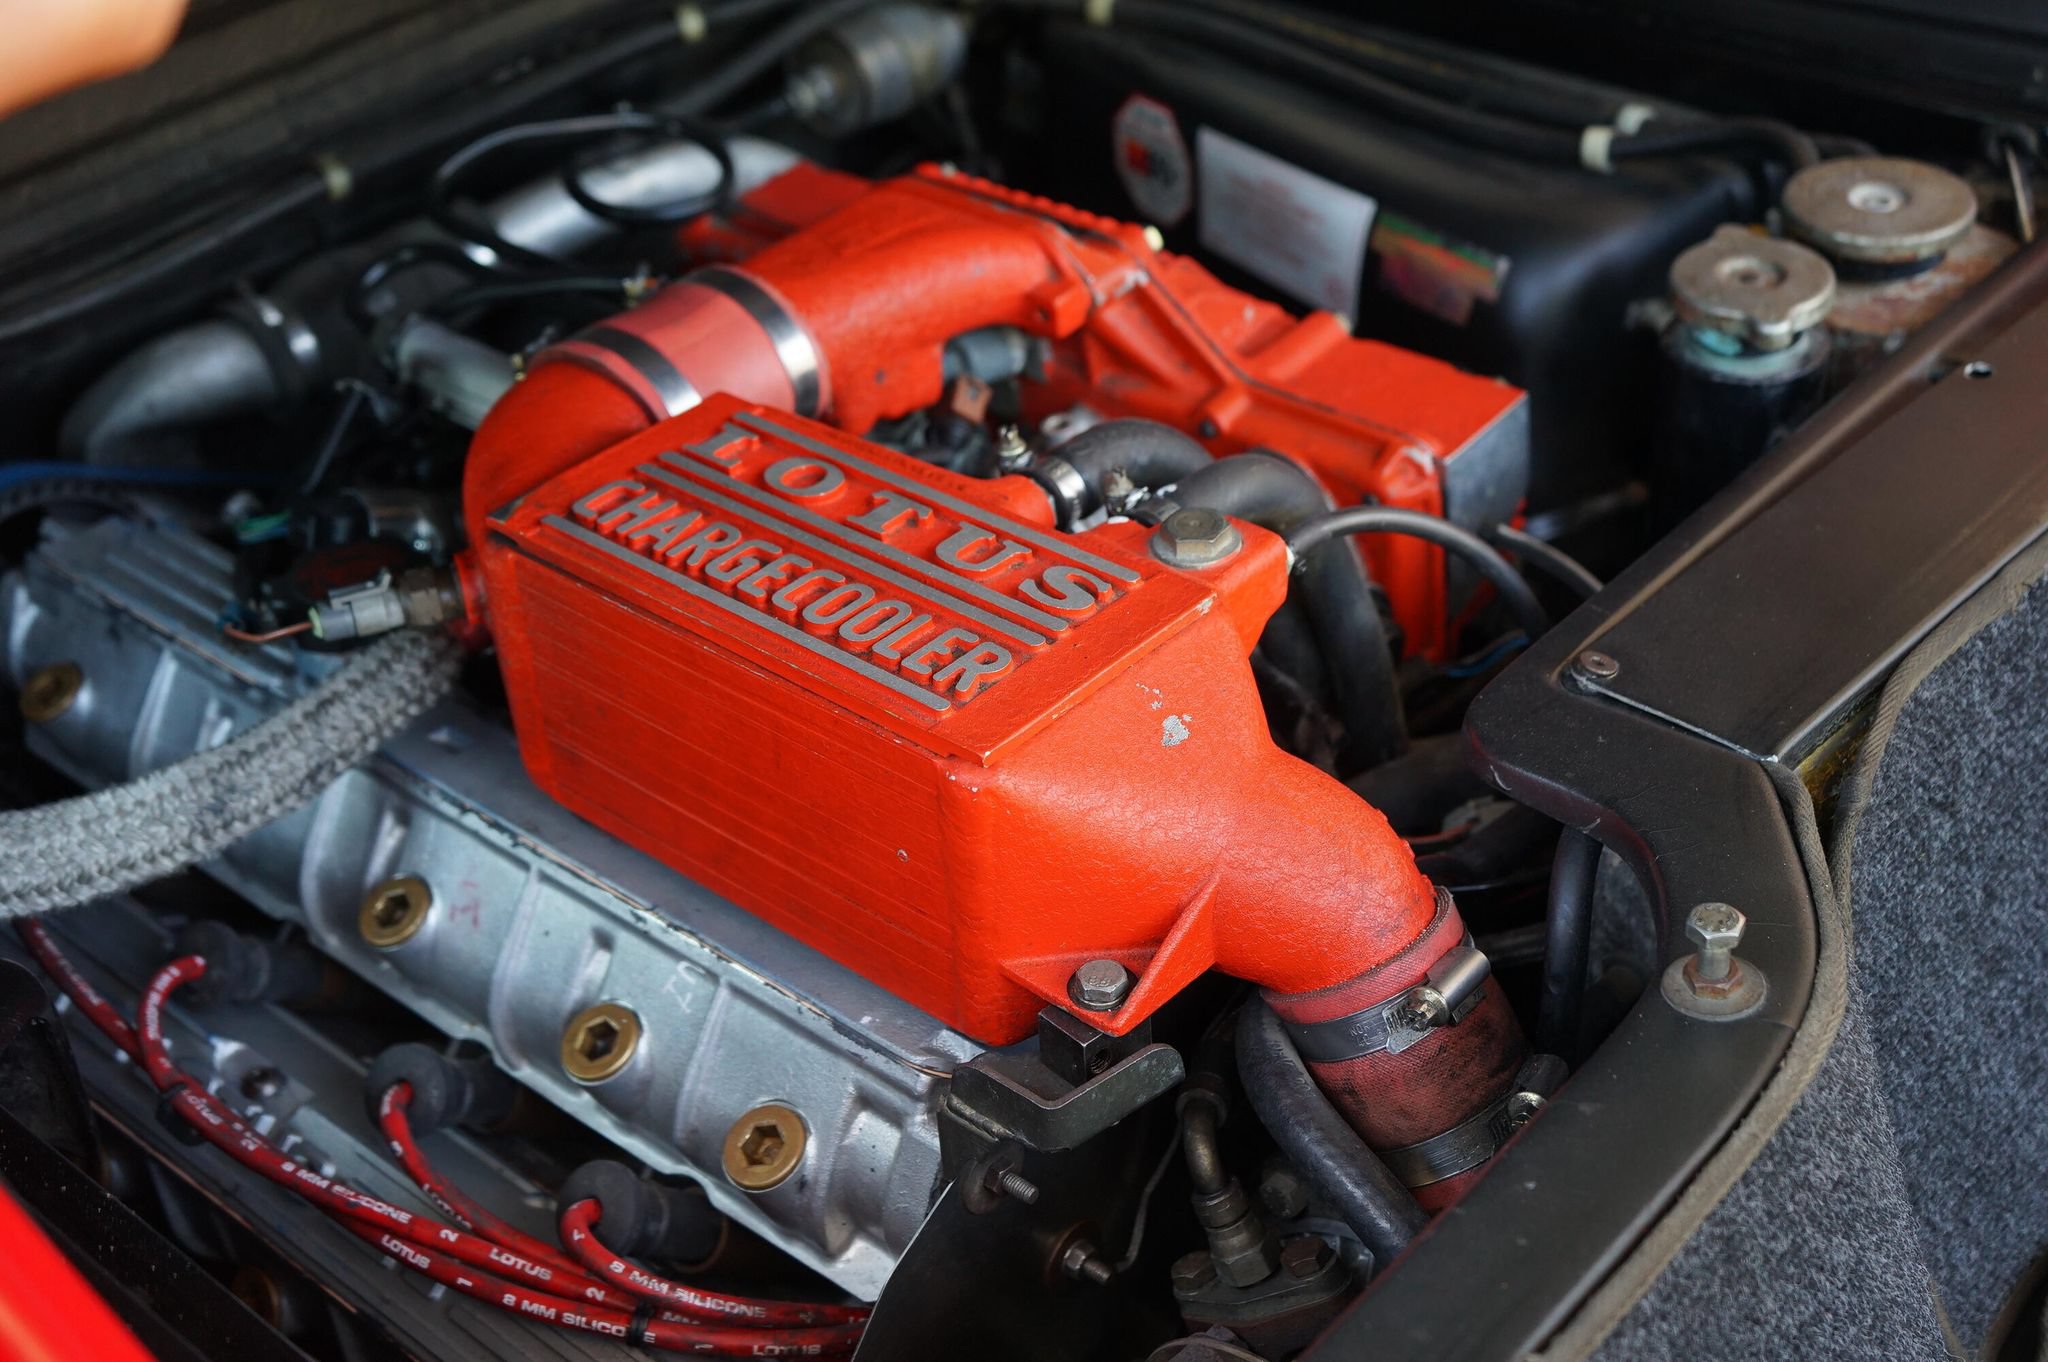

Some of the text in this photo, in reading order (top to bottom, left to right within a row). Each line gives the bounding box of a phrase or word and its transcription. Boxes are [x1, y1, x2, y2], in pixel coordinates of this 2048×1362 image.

[686, 423, 1114, 616] LOTUS
[571, 479, 1015, 698] CHARGECOOLER
[296, 1169, 331, 1189] MM
[439, 1228, 460, 1242] 2
[381, 1233, 431, 1269] LOTUS
[489, 1247, 606, 1301] LOTUS 2
[502, 1293, 517, 1307] 8
[521, 1299, 557, 1320] MM
[561, 1311, 657, 1344] SILICOE
[609, 1260, 626, 1273] 8
[628, 1270, 670, 1295] MM
[674, 1287, 766, 1319] SILICONE
